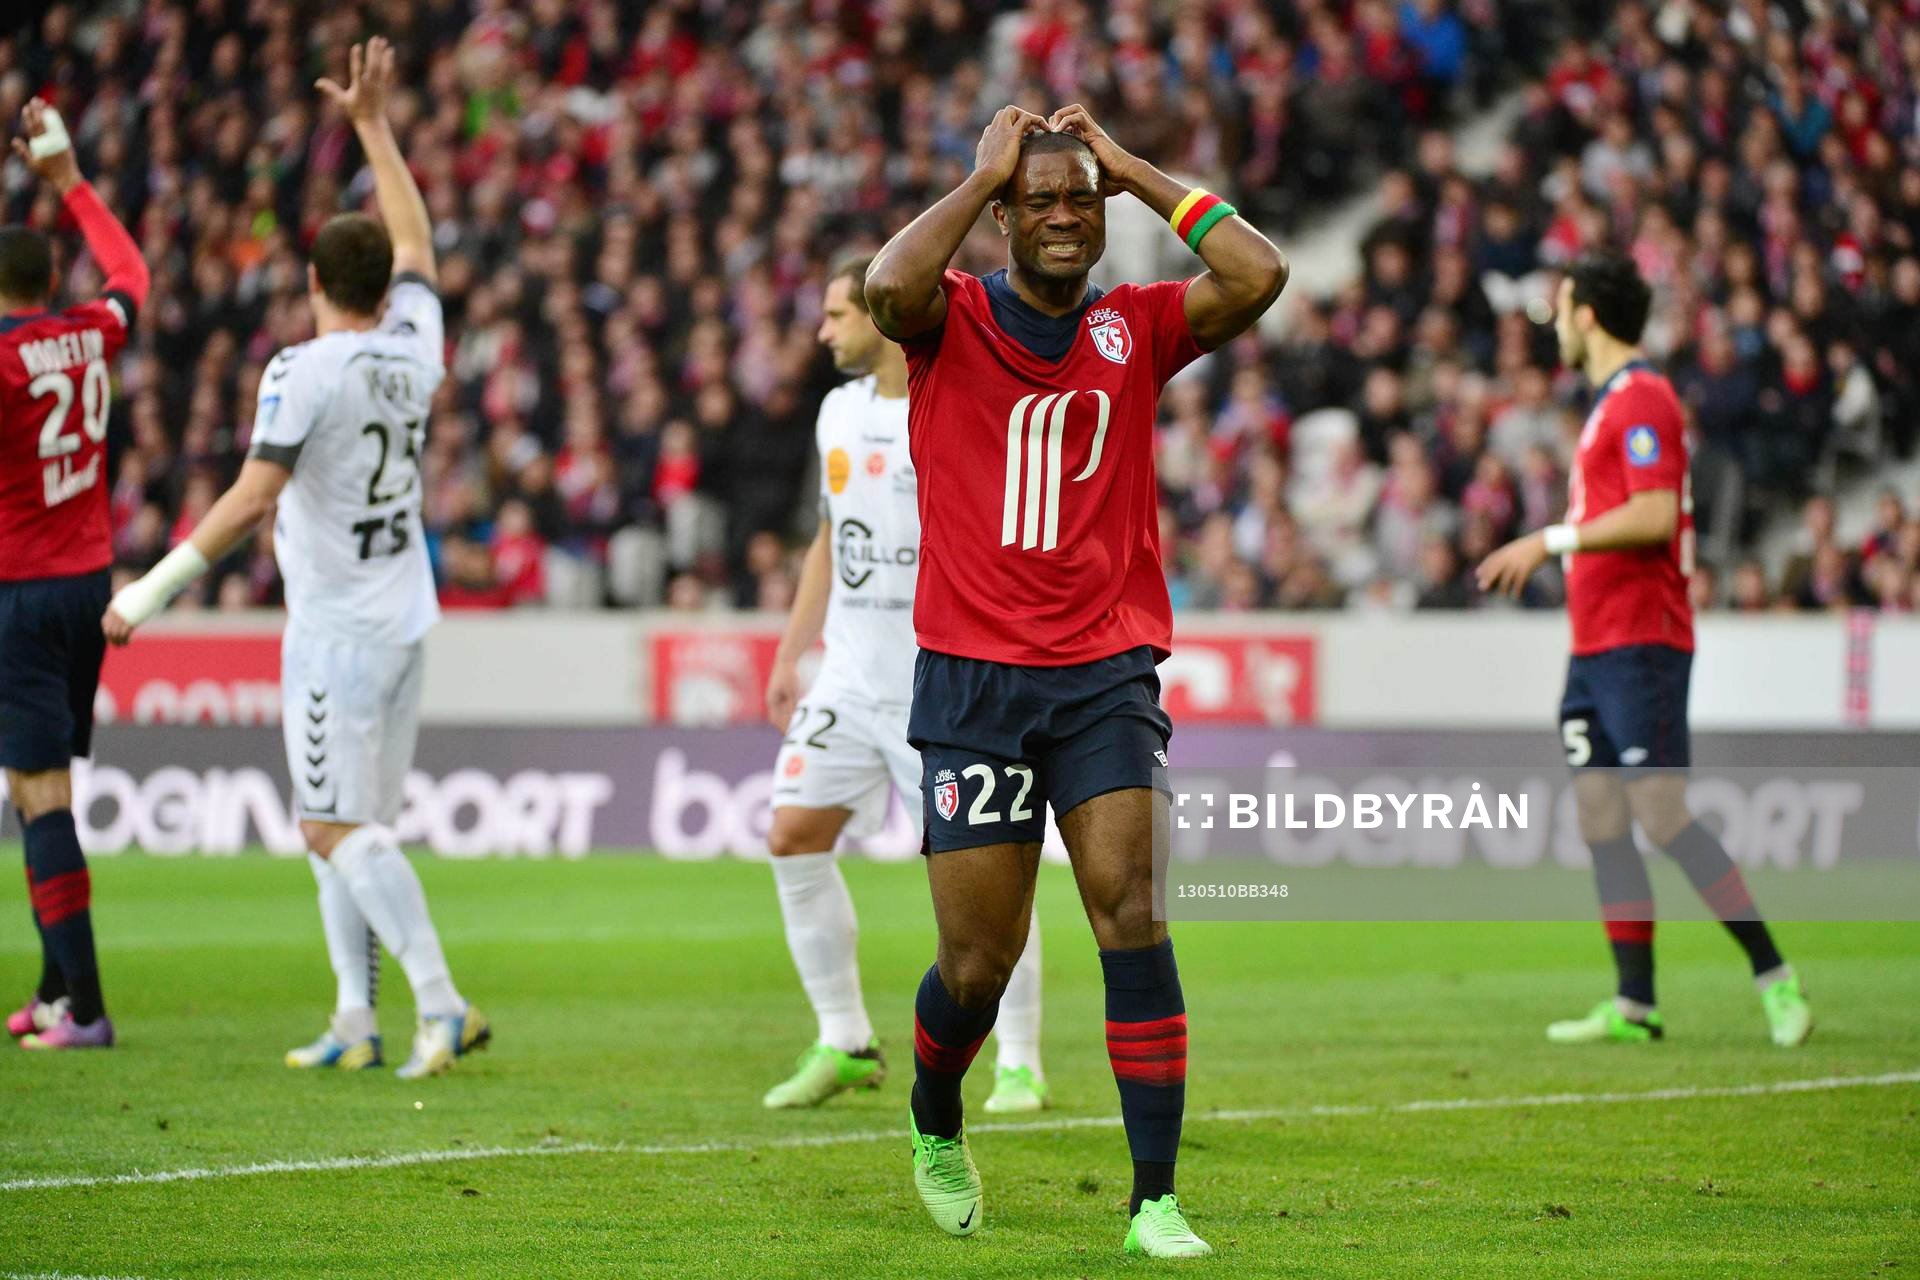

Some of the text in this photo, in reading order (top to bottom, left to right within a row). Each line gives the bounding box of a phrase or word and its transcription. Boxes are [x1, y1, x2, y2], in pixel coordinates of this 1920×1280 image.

[1086, 311, 1120, 325] LOSC
[1091, 307, 1111, 317] LILLE
[28, 357, 111, 460] 20
[352, 511, 409, 560] TS
[935, 772, 956, 783] LOSC
[962, 763, 1033, 825] 22
[394, 767, 614, 860] PORT
